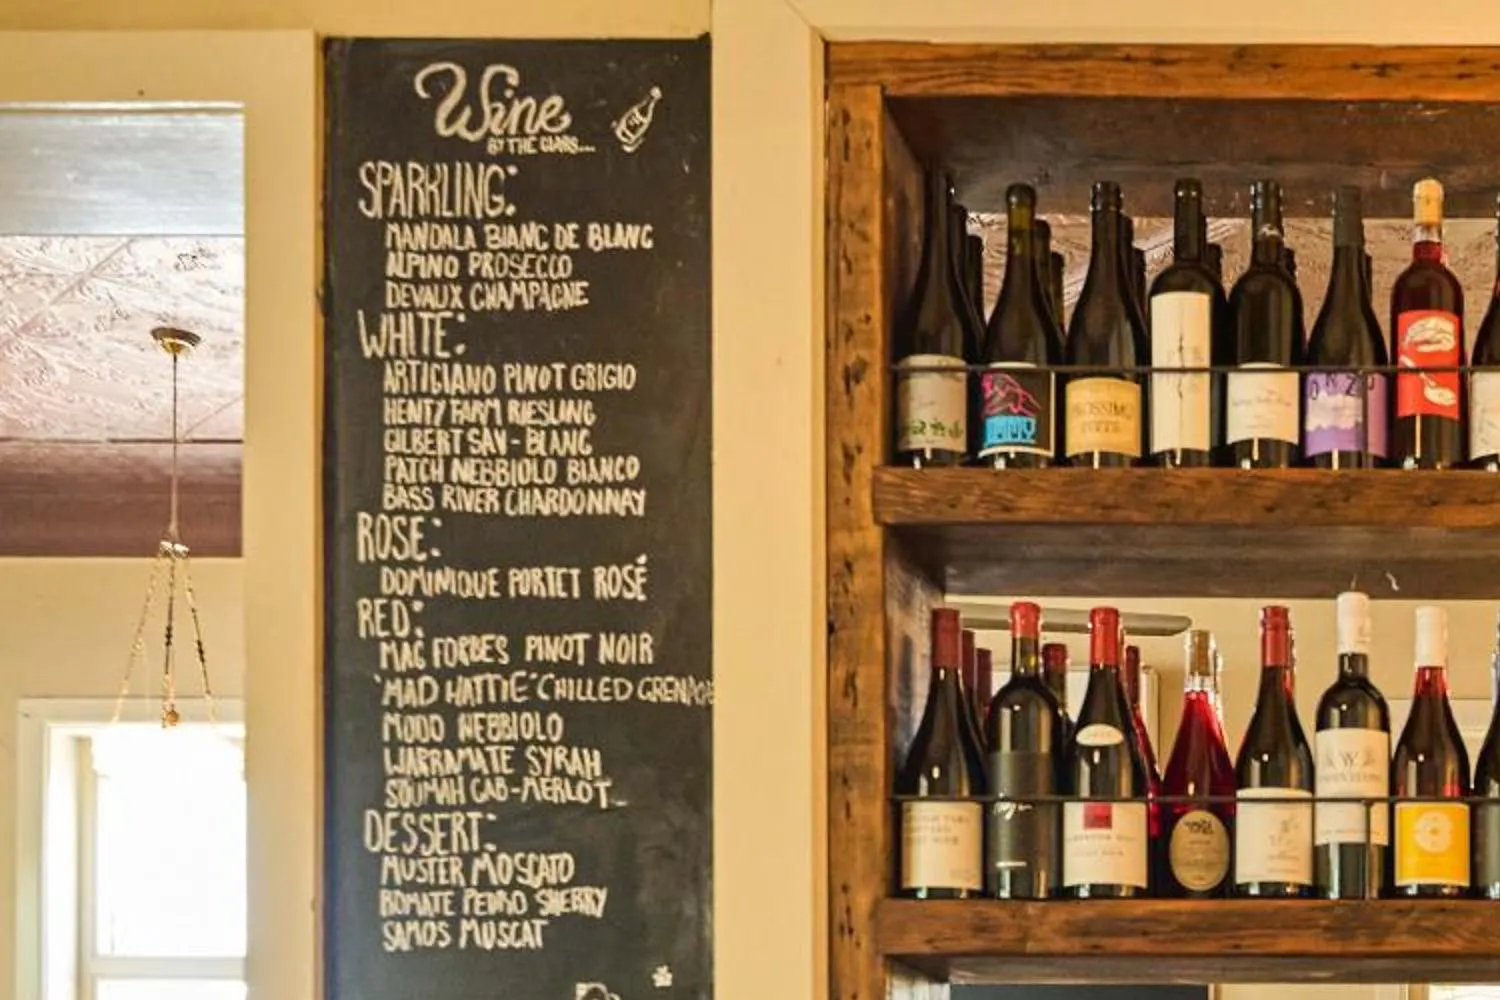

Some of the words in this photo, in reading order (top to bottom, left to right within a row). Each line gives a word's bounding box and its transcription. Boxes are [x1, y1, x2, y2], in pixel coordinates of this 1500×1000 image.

[414, 62, 571, 141] Wine
[509, 136, 537, 154] THE
[359, 160, 518, 219] SPARKLING:
[385, 222, 477, 250] MANDALA
[554, 223, 580, 250] DE
[587, 223, 653, 252] BLANC
[385, 252, 459, 279] ALPINO
[468, 251, 573, 279] PROSECCO
[385, 281, 464, 309] DEVAUX
[470, 281, 590, 311] CHAMPAGNE
[358, 309, 466, 359] WHITE:
[383, 360, 497, 395] ARTIGIANO
[503, 363, 566, 394] PINOT
[570, 363, 637, 391] GRIGIO
[383, 398, 447, 426] HENTY
[449, 398, 502, 426] FARM
[507, 398, 596, 427] RIESLING
[383, 427, 464, 456] GILBERT
[383, 455, 445, 484] PATCH
[450, 457, 557, 487] NEBBIOLO
[567, 455, 641, 484] BIANCO
[383, 483, 435, 511] BASS
[441, 484, 501, 514] RIVER
[504, 487, 646, 517] CHARDONNAY
[357, 511, 443, 563] ROSE:
[381, 565, 501, 599] DOMINIQUE
[509, 567, 580, 599] PORTET
[594, 554, 648, 601] ROSÉ
[358, 598, 425, 639] RED:
[431, 634, 510, 668] FORBES
[524, 632, 593, 667] PINOT
[599, 632, 654, 666] NOIR
[538, 673, 634, 702] CHILLED
[459, 711, 564, 743] NEBBIOLO
[383, 745, 516, 778] WARRAMATE
[525, 745, 602, 778] SYRAH
[384, 778, 466, 809] SOUMAH
[364, 808, 497, 855] DESSERT:
[381, 856, 465, 887] MUSTER
[471, 851, 576, 888] MOSCATO
[462, 888, 529, 916] PEDRO
[535, 886, 608, 919] SHERRY
[382, 919, 452, 952] SAMOS
[459, 918, 550, 951] MUSCAT
